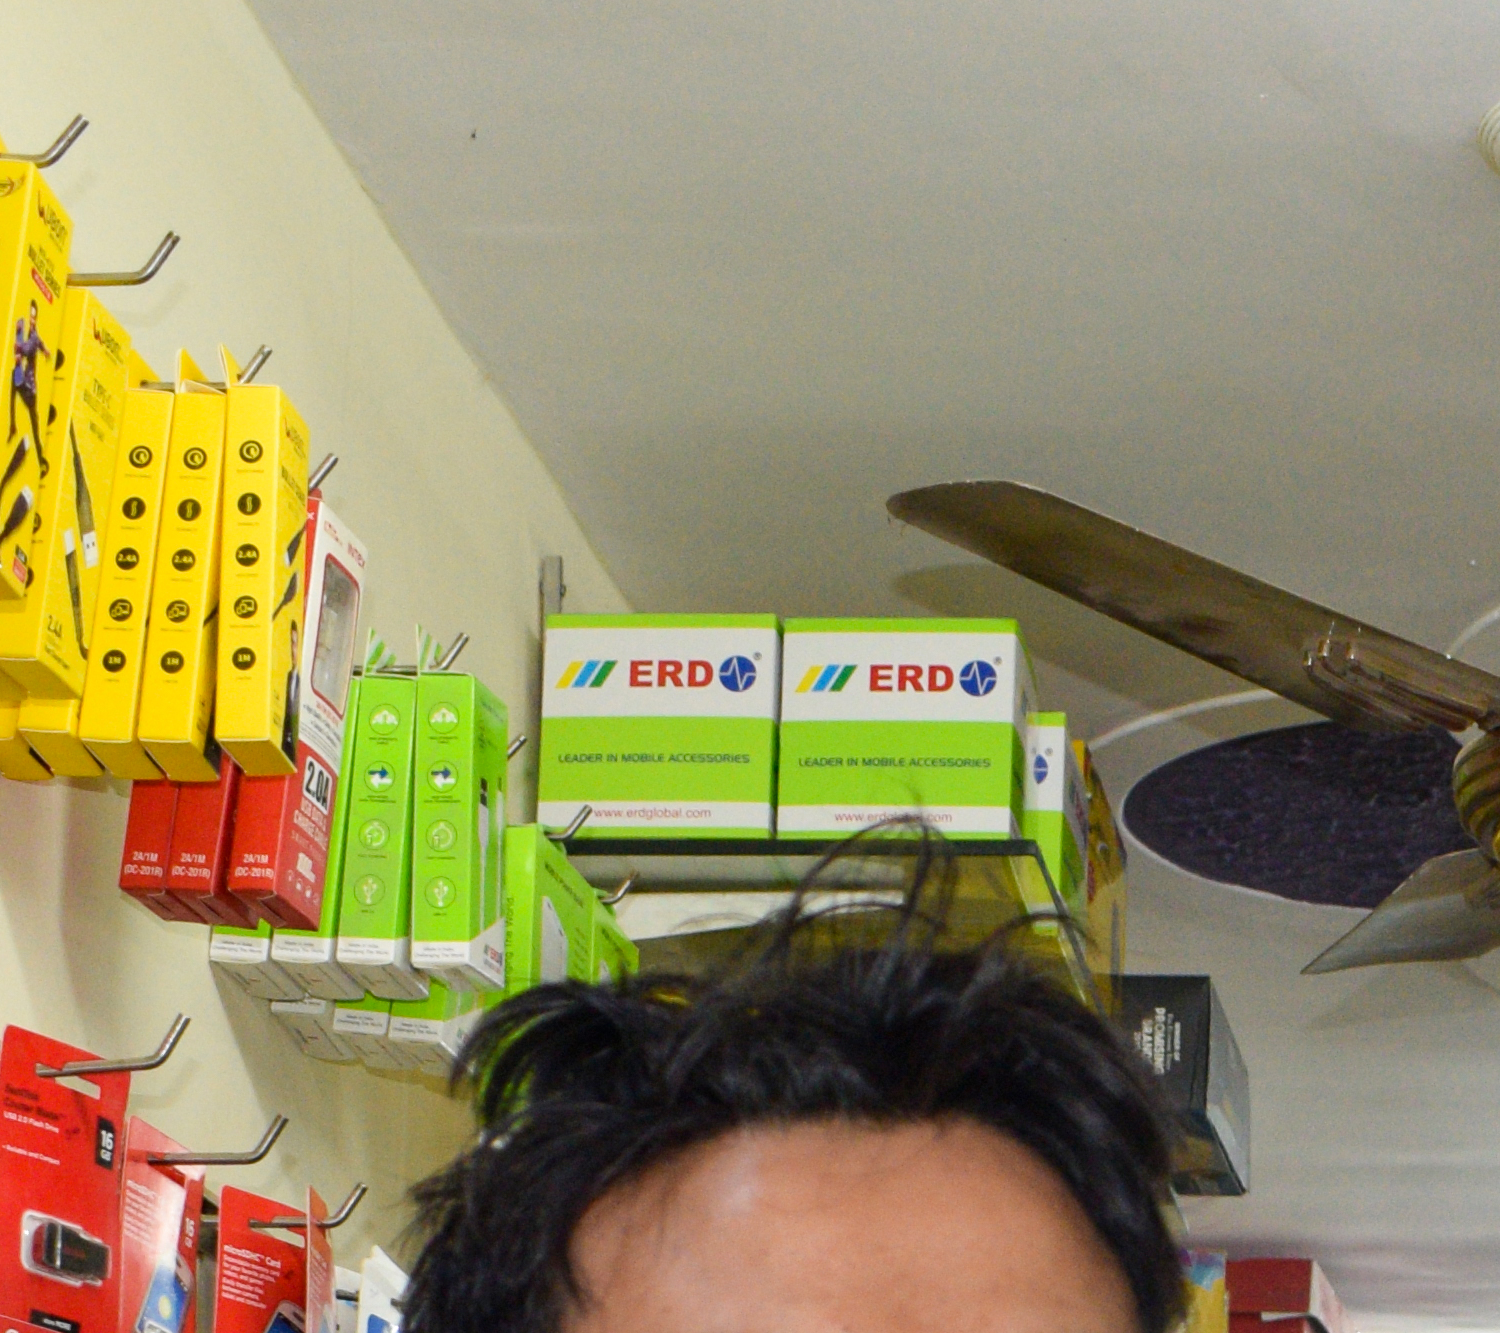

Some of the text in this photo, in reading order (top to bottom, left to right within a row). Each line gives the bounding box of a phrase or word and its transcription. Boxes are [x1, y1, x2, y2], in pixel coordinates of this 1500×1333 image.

[628, 659, 714, 688] ERD
[869, 664, 954, 693] ERD
[557, 753, 751, 765] LEADER IN MOBILE ACCESSORIES
[798, 757, 991, 769] LEADER IN MOBILE ACCESSORIES
[304, 759, 331, 813] 2.0A
[594, 806, 711, 820] www.erdglobal.com
[132, 852, 159, 863] 2A/1M
[180, 852, 206, 864] 2A/1M
[243, 853, 269, 864] 2A/1M
[100, 1129, 114, 1150] 16
